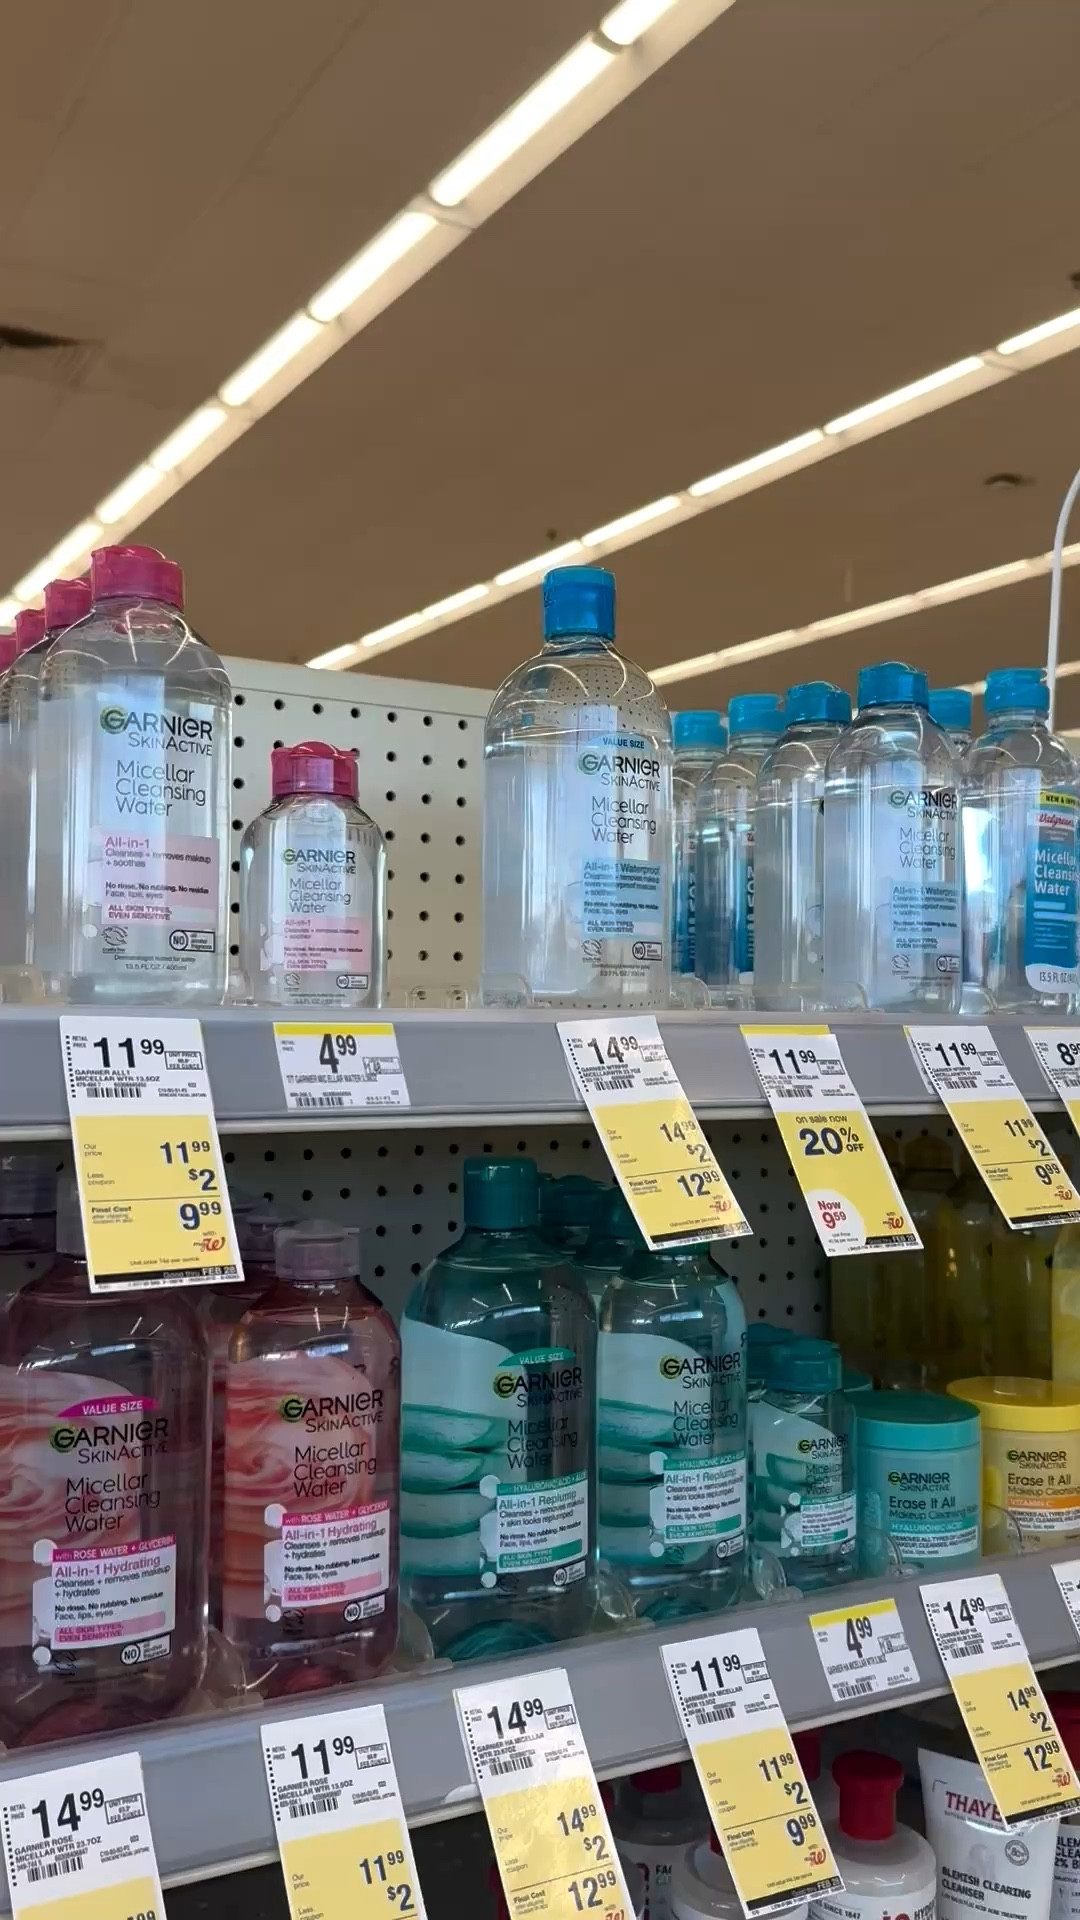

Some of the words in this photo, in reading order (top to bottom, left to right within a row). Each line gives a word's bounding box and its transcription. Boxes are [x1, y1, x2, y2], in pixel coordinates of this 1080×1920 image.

[102, 706, 212, 741] GARNIER
[128, 731, 212, 756] SKINACTIVE
[603, 737, 629, 747] VALUE
[630, 738, 645, 749] SIZE
[117, 760, 195, 784] Micellar
[579, 753, 660, 778] GARNIER
[601, 772, 660, 791] SKINACTIVE
[116, 778, 206, 806] Cleansing
[116, 796, 172, 816] Water
[592, 796, 649, 815] Micellar
[592, 812, 656, 835] Cleansing
[106, 836, 150, 848] All-in-1
[592, 828, 634, 844] Water
[900, 828, 950, 843] Micellar
[283, 849, 356, 865] GARNIER
[899, 842, 955, 859] Cleansing
[297, 863, 356, 874] SKINACTIVE
[900, 856, 937, 869] Water
[289, 878, 342, 890] Micellar
[1034, 880, 1069, 896] Water
[289, 890, 351, 905] Cleansing
[289, 903, 326, 913] Water
[796, 1116, 808, 1124] on
[810, 1115, 827, 1123] sale
[846, 1144, 864, 1152] OFF
[818, 1200, 841, 1210] Now
[202, 1267, 222, 1276] FEB
[519, 1354, 545, 1366] VALUE
[548, 1352, 564, 1361] SIZE
[662, 1352, 741, 1377] GARNIER
[495, 1367, 582, 1395] GARNIER
[82, 1403, 116, 1416] VALUE
[120, 1400, 143, 1412] SIZE
[282, 1389, 384, 1422] GARNIER
[306, 1411, 384, 1433] SKINACTIVE
[52, 1418, 169, 1451] GARNIER
[673, 1432, 716, 1448] Water
[78, 1440, 168, 1465] SKINACTIVE
[295, 1442, 366, 1463] Micellar
[1007, 1450, 1067, 1461] GARNIER
[507, 1452, 552, 1470] Water
[1020, 1461, 1067, 1469] SKINACTIVE
[294, 1458, 377, 1482] Cleansing
[888, 1472, 950, 1484] GARNIER
[66, 1473, 148, 1496] Micellar
[666, 1473, 700, 1484] All-in-1
[1008, 1473, 1043, 1486] Erase
[1058, 1474, 1071, 1485] All
[294, 1479, 347, 1498] Water
[65, 1490, 161, 1516] Cleansing
[499, 1497, 536, 1510] All-in-1
[538, 1491, 577, 1506] Replump
[889, 1496, 926, 1509] Erase
[941, 1496, 956, 1509] All
[301, 1513, 322, 1523] ROSE
[324, 1510, 350, 1520] WATER
[500, 1509, 533, 1518] Cleanses
[506, 1518, 520, 1527] skin
[523, 1516, 541, 1526] looks
[889, 1510, 926, 1520] Makeup
[65, 1512, 124, 1533] Water
[285, 1529, 325, 1541] All-in-1
[328, 1520, 377, 1538] Hydrating
[73, 1548, 97, 1559] ROSE
[100, 1545, 128, 1557] WATER
[139, 1535, 174, 1551] GLYCERIN
[284, 1540, 320, 1550] Cleanses
[329, 1535, 360, 1547] removes
[292, 1550, 326, 1560] hydrates
[55, 1565, 100, 1578] All-in-1
[103, 1555, 161, 1575] Hydrating
[55, 1578, 95, 1588] Cleanses
[104, 1571, 140, 1584] removes
[62, 1587, 100, 1598] hydrates
[346, 1607, 358, 1617] NO
[124, 1649, 137, 1660] NO
[718, 1686, 743, 1697] MICELLAR
[277, 1781, 309, 1793] GARNIER
[309, 1777, 328, 1786] ROSE
[278, 1789, 313, 1800] MICELLAR
[314, 1785, 330, 1793] WTR
[727, 1832, 741, 1842] Final
[742, 1829, 755, 1838] Cost
[15, 1840, 50, 1854] GARNIER
[52, 1835, 73, 1846] ROSE
[16, 1849, 55, 1862] MICELLAR
[57, 1844, 75, 1853] WTR
[77, 1836, 102, 1848] 23.7OZ
[292, 1873, 304, 1882] Our
[293, 1881, 309, 1890] price
[942, 1867, 979, 1886] BLEMISH
[983, 1880, 1031, 1899] CLEARING
[514, 1894, 530, 1904] Final
[531, 1890, 546, 1899] Cost
[942, 1879, 985, 1901] CLEANSER
[298, 1907, 313, 1915] Less
[823, 1902, 842, 1916] SINCE
[845, 1909, 861, 1919] 1847
